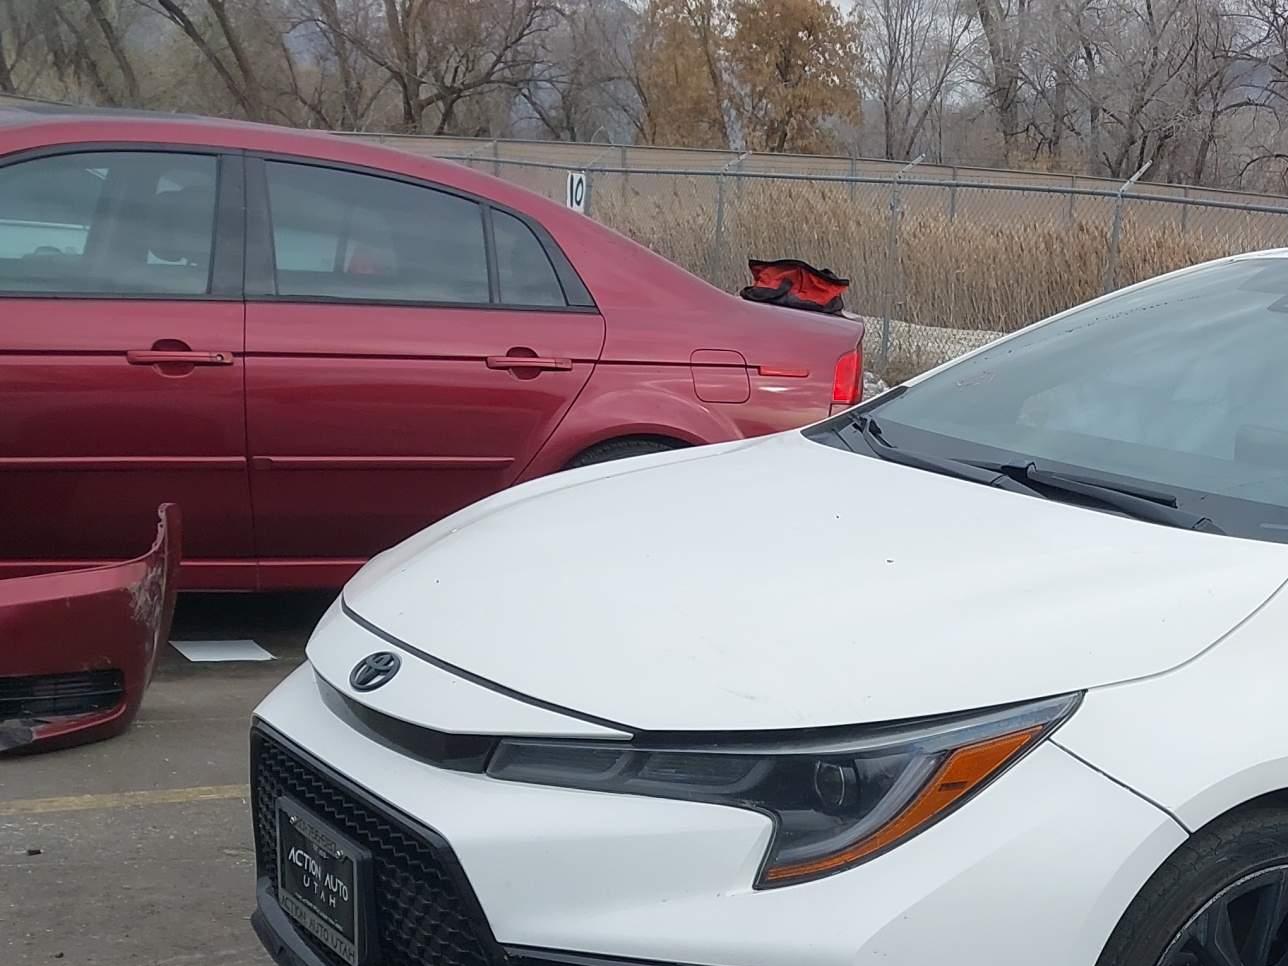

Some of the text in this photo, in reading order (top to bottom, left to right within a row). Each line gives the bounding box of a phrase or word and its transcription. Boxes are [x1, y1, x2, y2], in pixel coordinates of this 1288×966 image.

[570, 175, 584, 208] 10
[288, 847, 321, 881] ACTION
[325, 873, 349, 901] AUTO
[303, 876, 336, 908] UTAH
